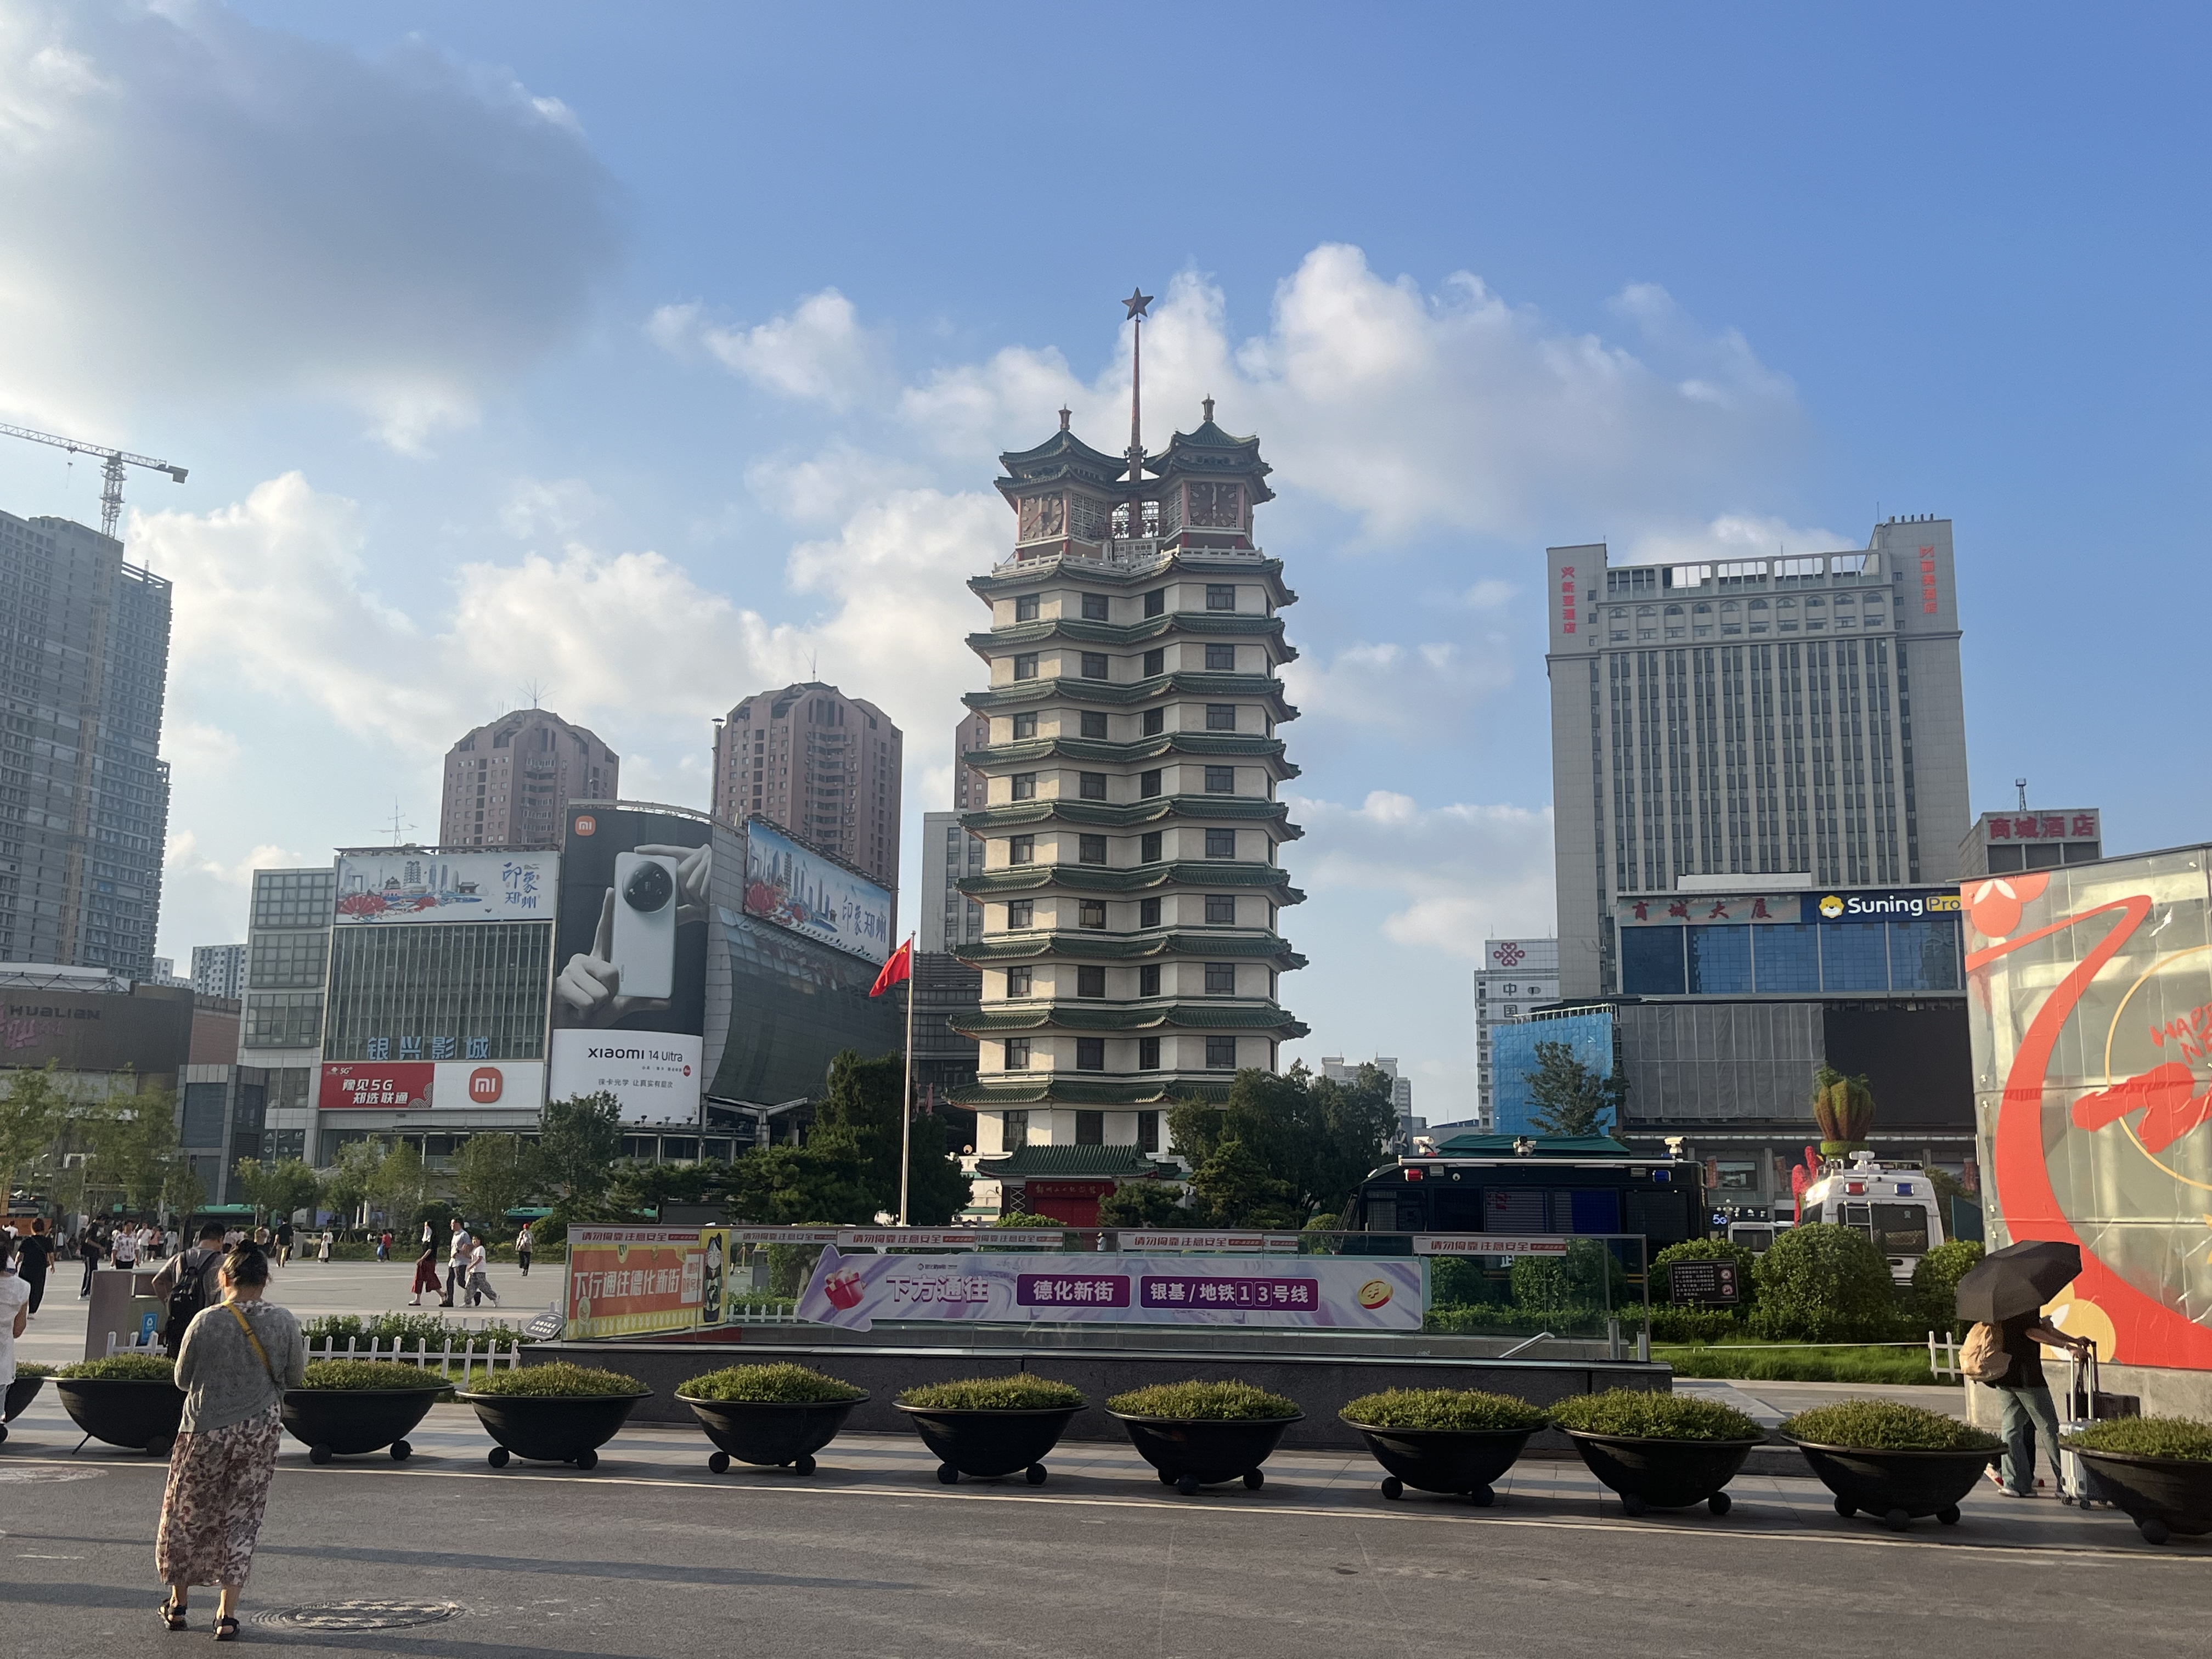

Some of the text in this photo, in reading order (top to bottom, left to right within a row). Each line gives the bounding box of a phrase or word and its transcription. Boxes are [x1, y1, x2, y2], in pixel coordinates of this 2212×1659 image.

[1988, 814, 2094, 839] 商城酒店
[505, 891, 537, 909] 郑州
[1848, 895, 1961, 916] Suning Pro
[368, 1036, 489, 1060] 银兴影城
[648, 1050, 659, 1060] 14
[662, 1051, 683, 1062] Ultra
[574, 1268, 681, 1300] 下行通往德化新街
[887, 1274, 989, 1303] 下方通往
[1034, 1280, 1114, 1302] 德化新街
